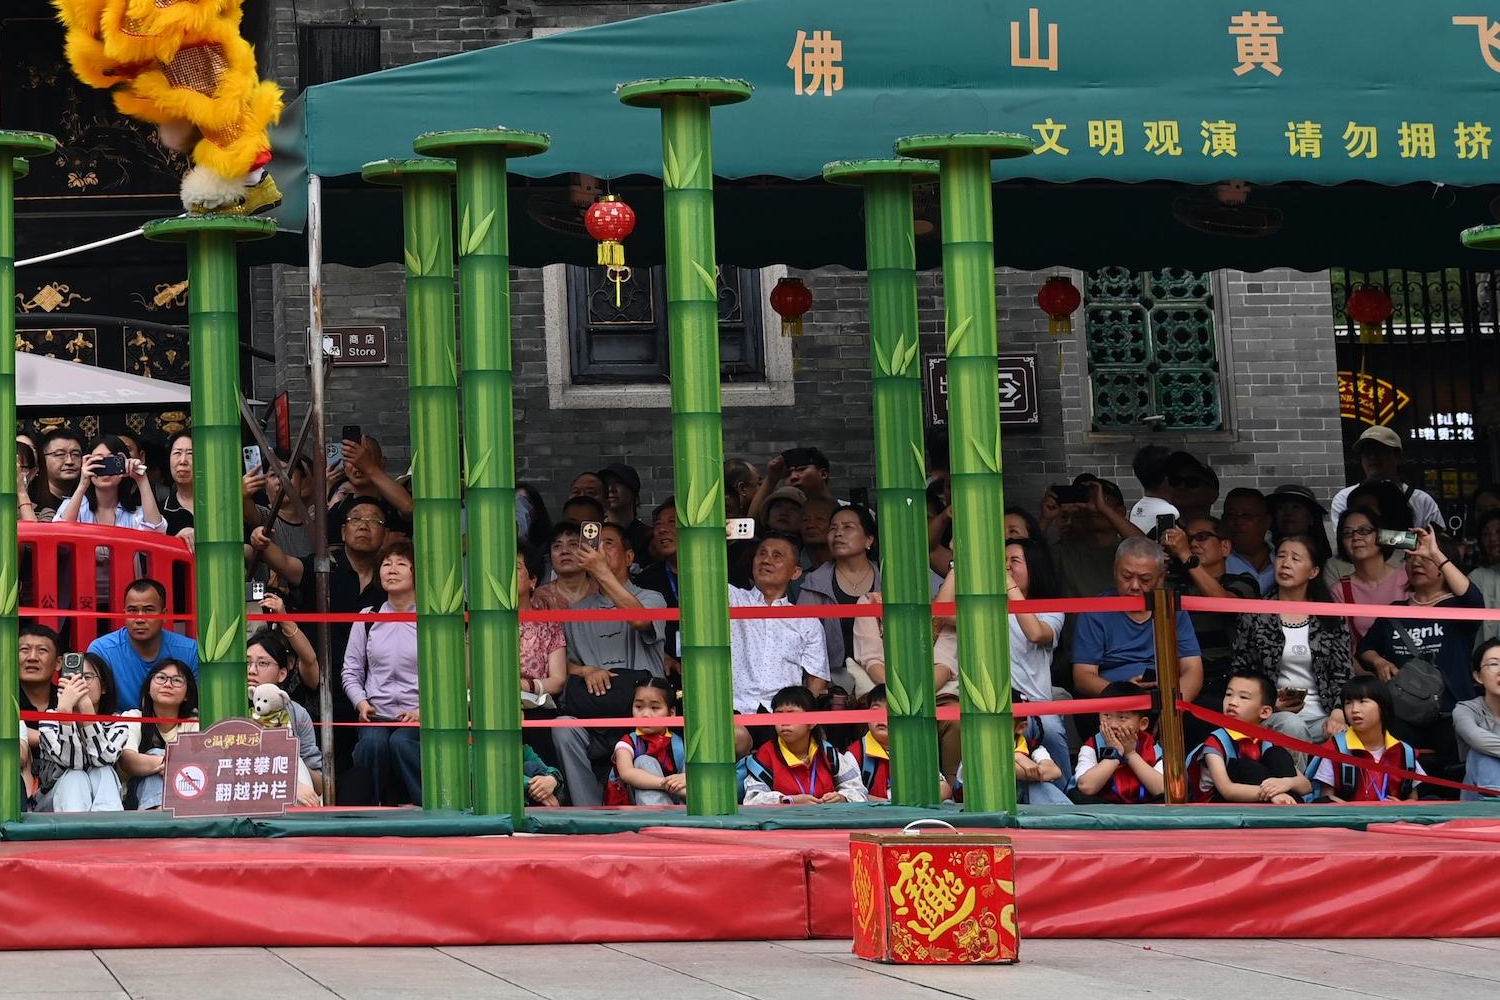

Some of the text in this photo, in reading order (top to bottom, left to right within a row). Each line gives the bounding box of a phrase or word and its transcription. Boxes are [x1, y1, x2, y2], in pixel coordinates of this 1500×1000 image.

[1032, 117, 1492, 160] 文明观演 请勿拥挤
[349, 334, 375, 345] 商店
[349, 347, 377, 356] Store
[41, 595, 93, 609] 公安
[217, 756, 288, 776] 严禁攀爬
[215, 781, 288, 802] 翻越护栏
